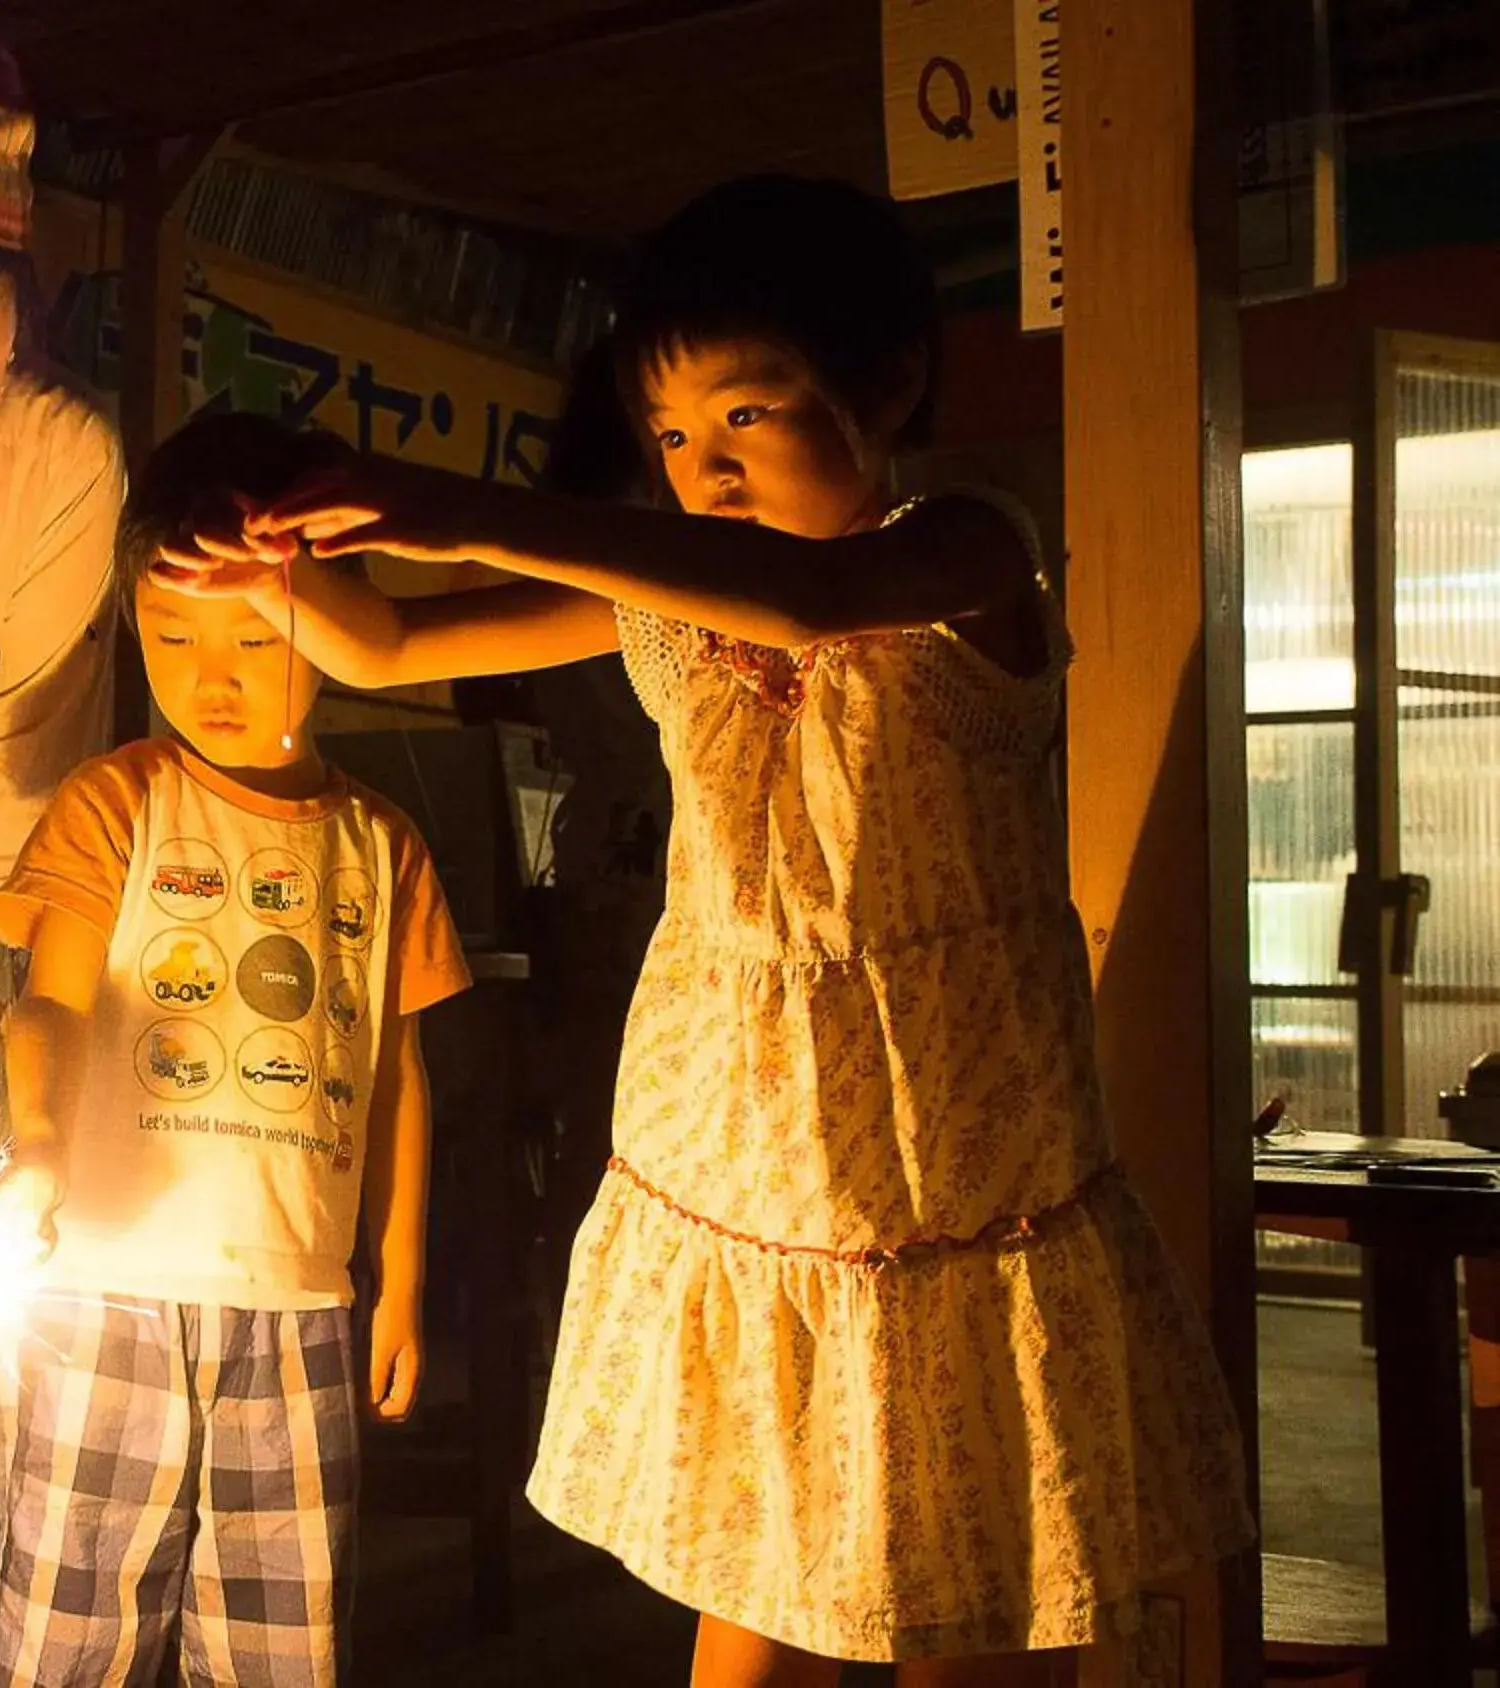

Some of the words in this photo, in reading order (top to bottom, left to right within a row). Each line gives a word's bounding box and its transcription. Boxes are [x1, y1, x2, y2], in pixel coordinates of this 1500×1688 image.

[138, 1112, 171, 1132] Let's
[174, 1114, 210, 1133] build
[214, 1118, 261, 1139] tomica
[265, 1126, 299, 1146] world
